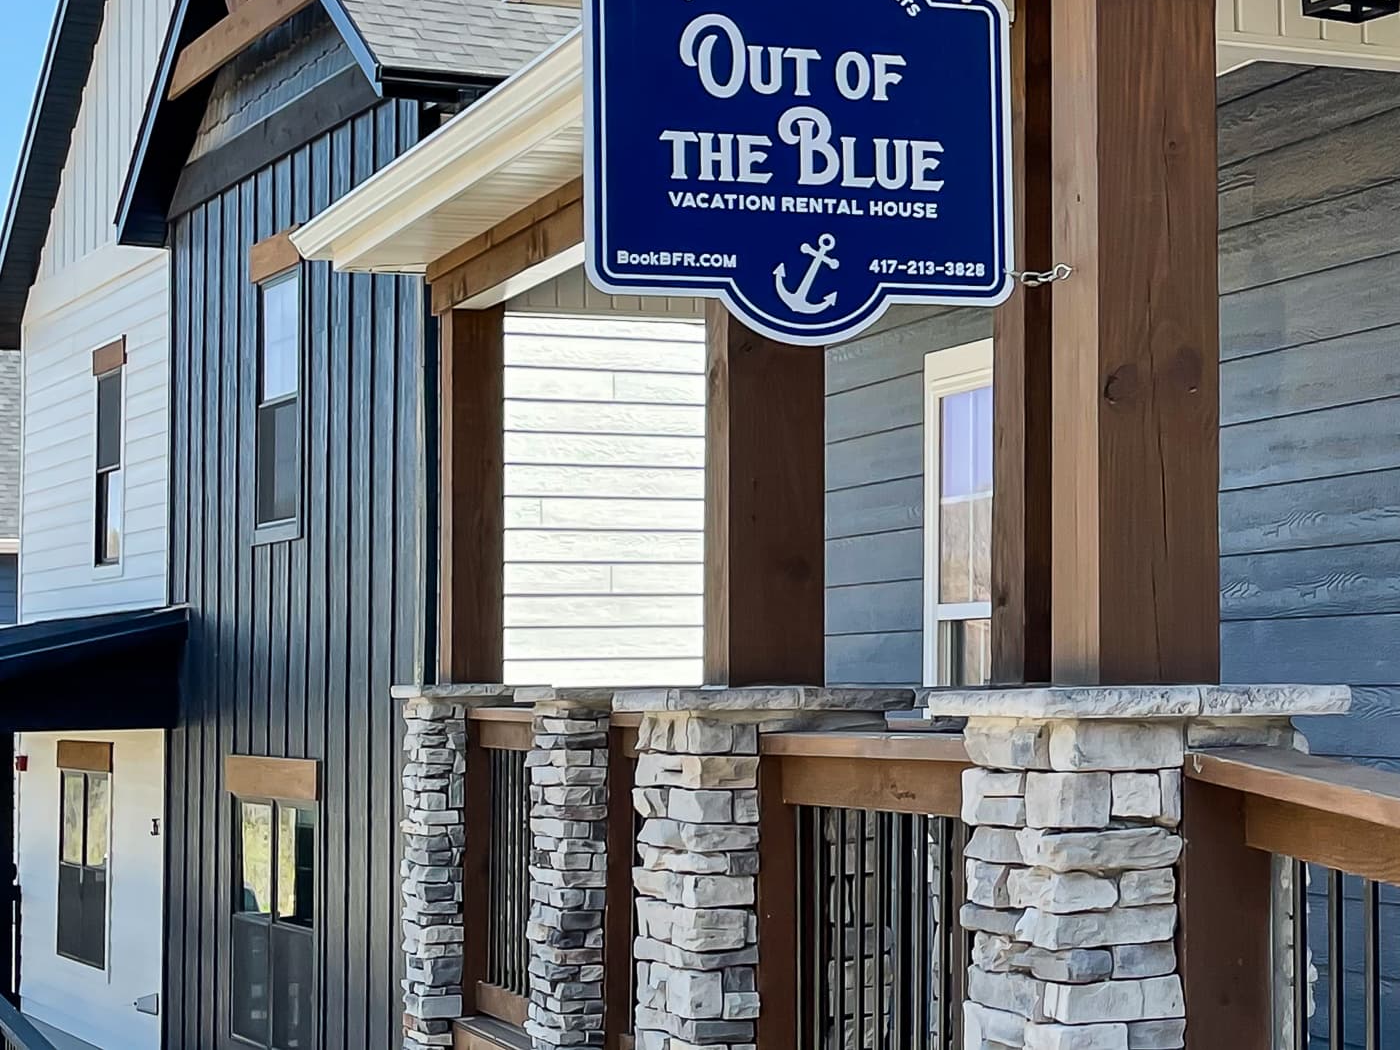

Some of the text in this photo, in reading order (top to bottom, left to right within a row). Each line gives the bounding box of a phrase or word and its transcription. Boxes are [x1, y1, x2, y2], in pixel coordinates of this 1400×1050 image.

[835, 51, 907, 101] OF
[658, 129, 774, 184] THE
[668, 190, 938, 219] VACATION RENTAL HOUSE
[868, 259, 986, 277] 417-213-3828
